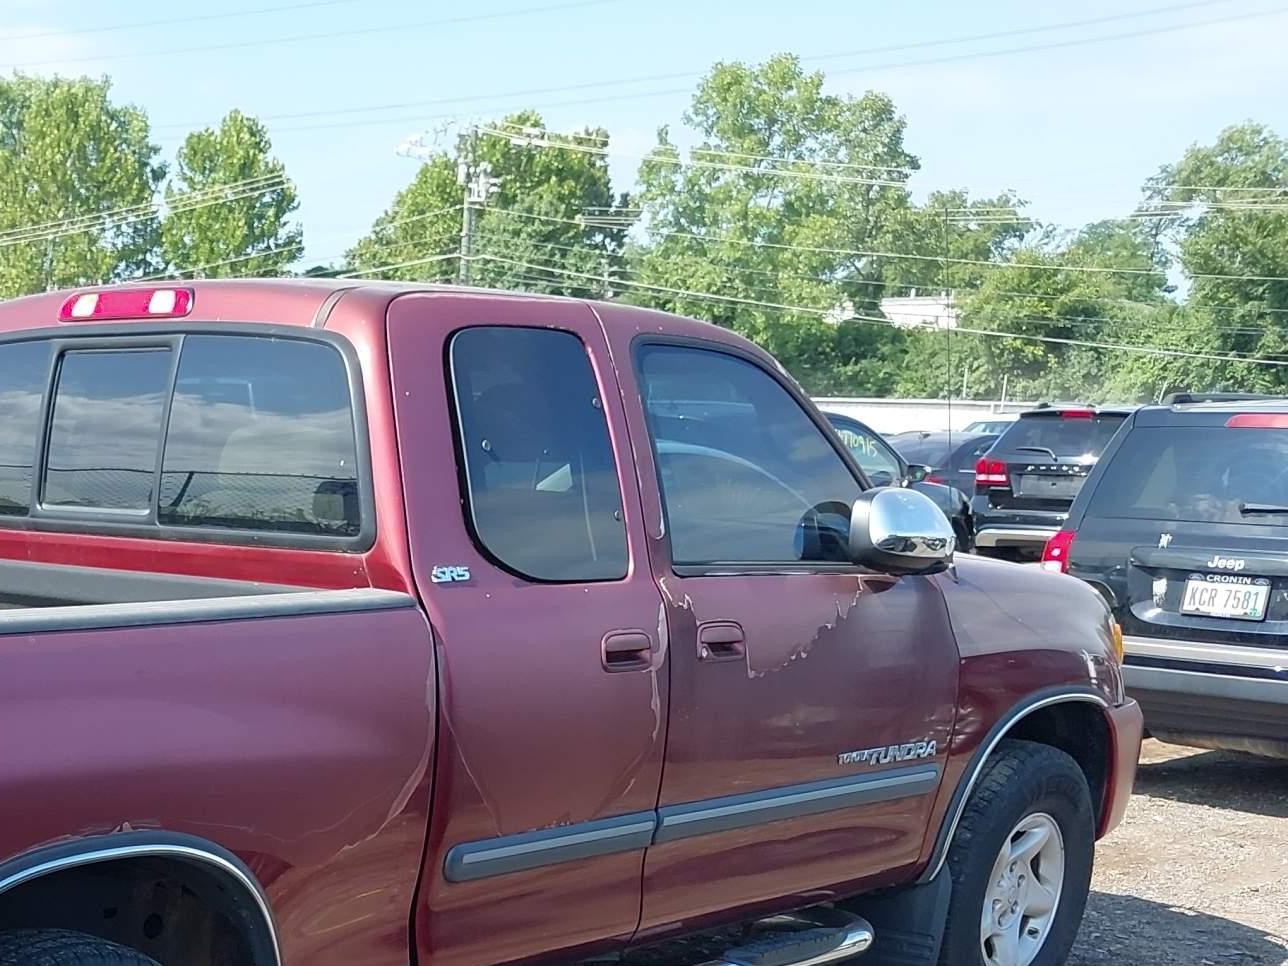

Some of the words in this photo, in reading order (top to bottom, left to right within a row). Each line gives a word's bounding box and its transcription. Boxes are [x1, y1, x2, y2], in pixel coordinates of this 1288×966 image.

[1207, 555, 1245, 571] Jeep
[1206, 574, 1252, 585] CRONIN
[1188, 586, 1218, 607] KCR
[1224, 588, 1260, 610] 7581
[870, 740, 937, 765] TUNDRA
